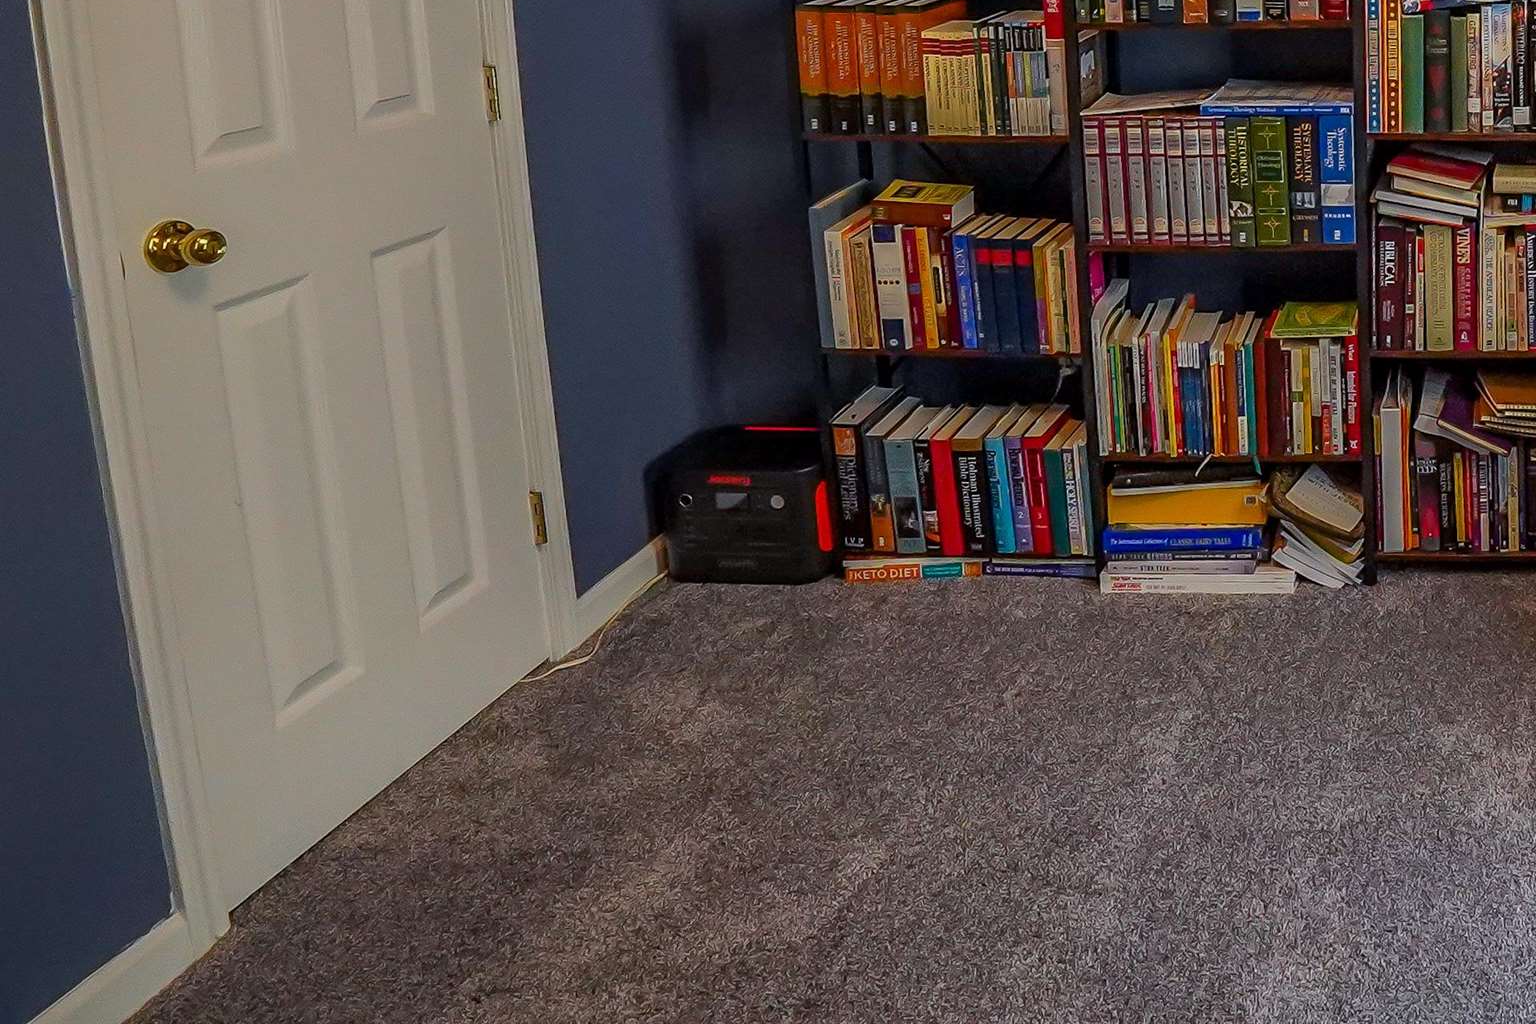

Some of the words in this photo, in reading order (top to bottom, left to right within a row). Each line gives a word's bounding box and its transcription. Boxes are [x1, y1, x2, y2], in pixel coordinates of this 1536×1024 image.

[1228, 128, 1239, 186] THEOLOGY
[1236, 126, 1249, 189] HISTORICAL
[1293, 126, 1304, 182] THEOLOGY
[1301, 122, 1313, 185] SYSTEMATIC
[1324, 129, 1336, 168] Theology
[1337, 127, 1347, 172] Systematic
[1384, 241, 1395, 287] BIBLICAL
[1456, 228, 1471, 264] VINE'S
[1527, 232, 1536, 270] AMERICAN
[1486, 271, 1494, 304] AMERICAN
[1528, 270, 1536, 301] HISTORY
[1486, 305, 1494, 332] READER
[959, 457, 968, 479] Bible
[968, 456, 978, 492] Holman
[961, 481, 973, 526] Dictionary
[1064, 480, 1075, 505] HOLY
[972, 494, 985, 538] Illustrated
[1068, 506, 1079, 534] SPIRIT
[854, 569, 888, 580] KETO
[889, 567, 919, 579] DIET
